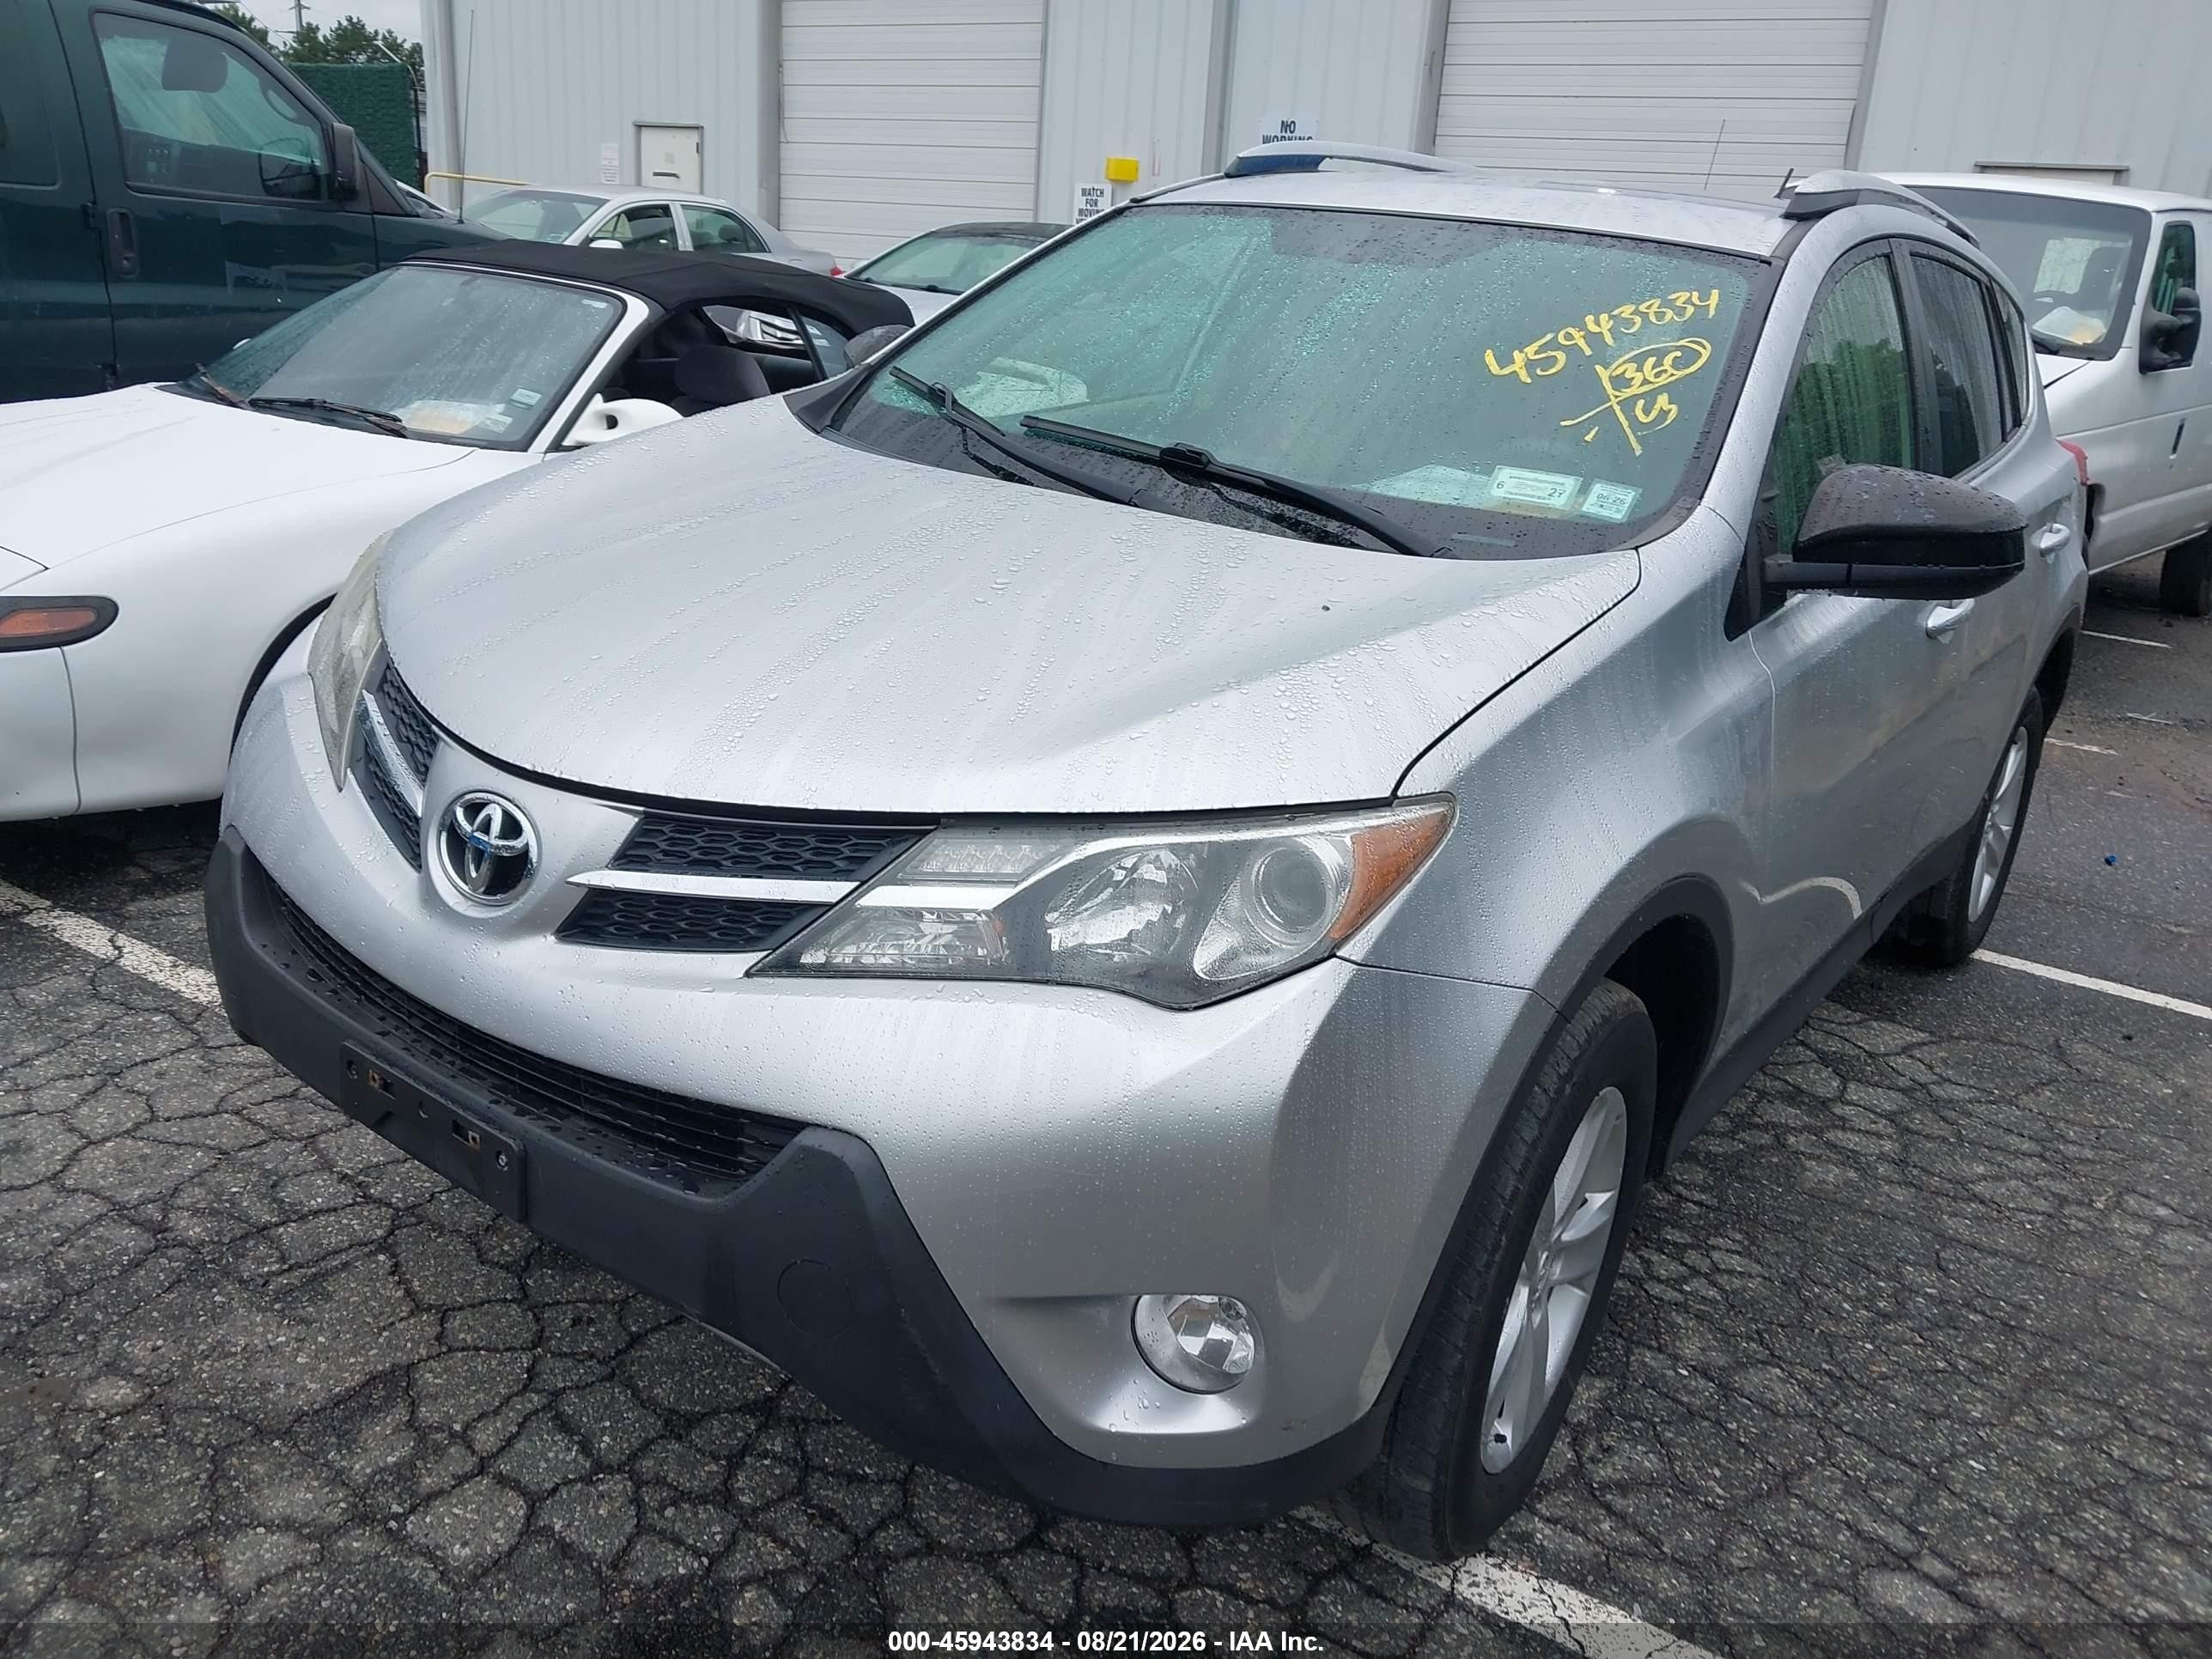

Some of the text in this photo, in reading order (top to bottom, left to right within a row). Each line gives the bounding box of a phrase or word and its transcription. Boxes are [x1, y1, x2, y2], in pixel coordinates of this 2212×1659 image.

[1280, 119, 1296, 134] NO
[1081, 187, 1104, 198] WATCH
[1085, 198, 1099, 207] FOR
[1079, 207, 1104, 217] MOVIN
[1484, 289, 1719, 384] 45943834
